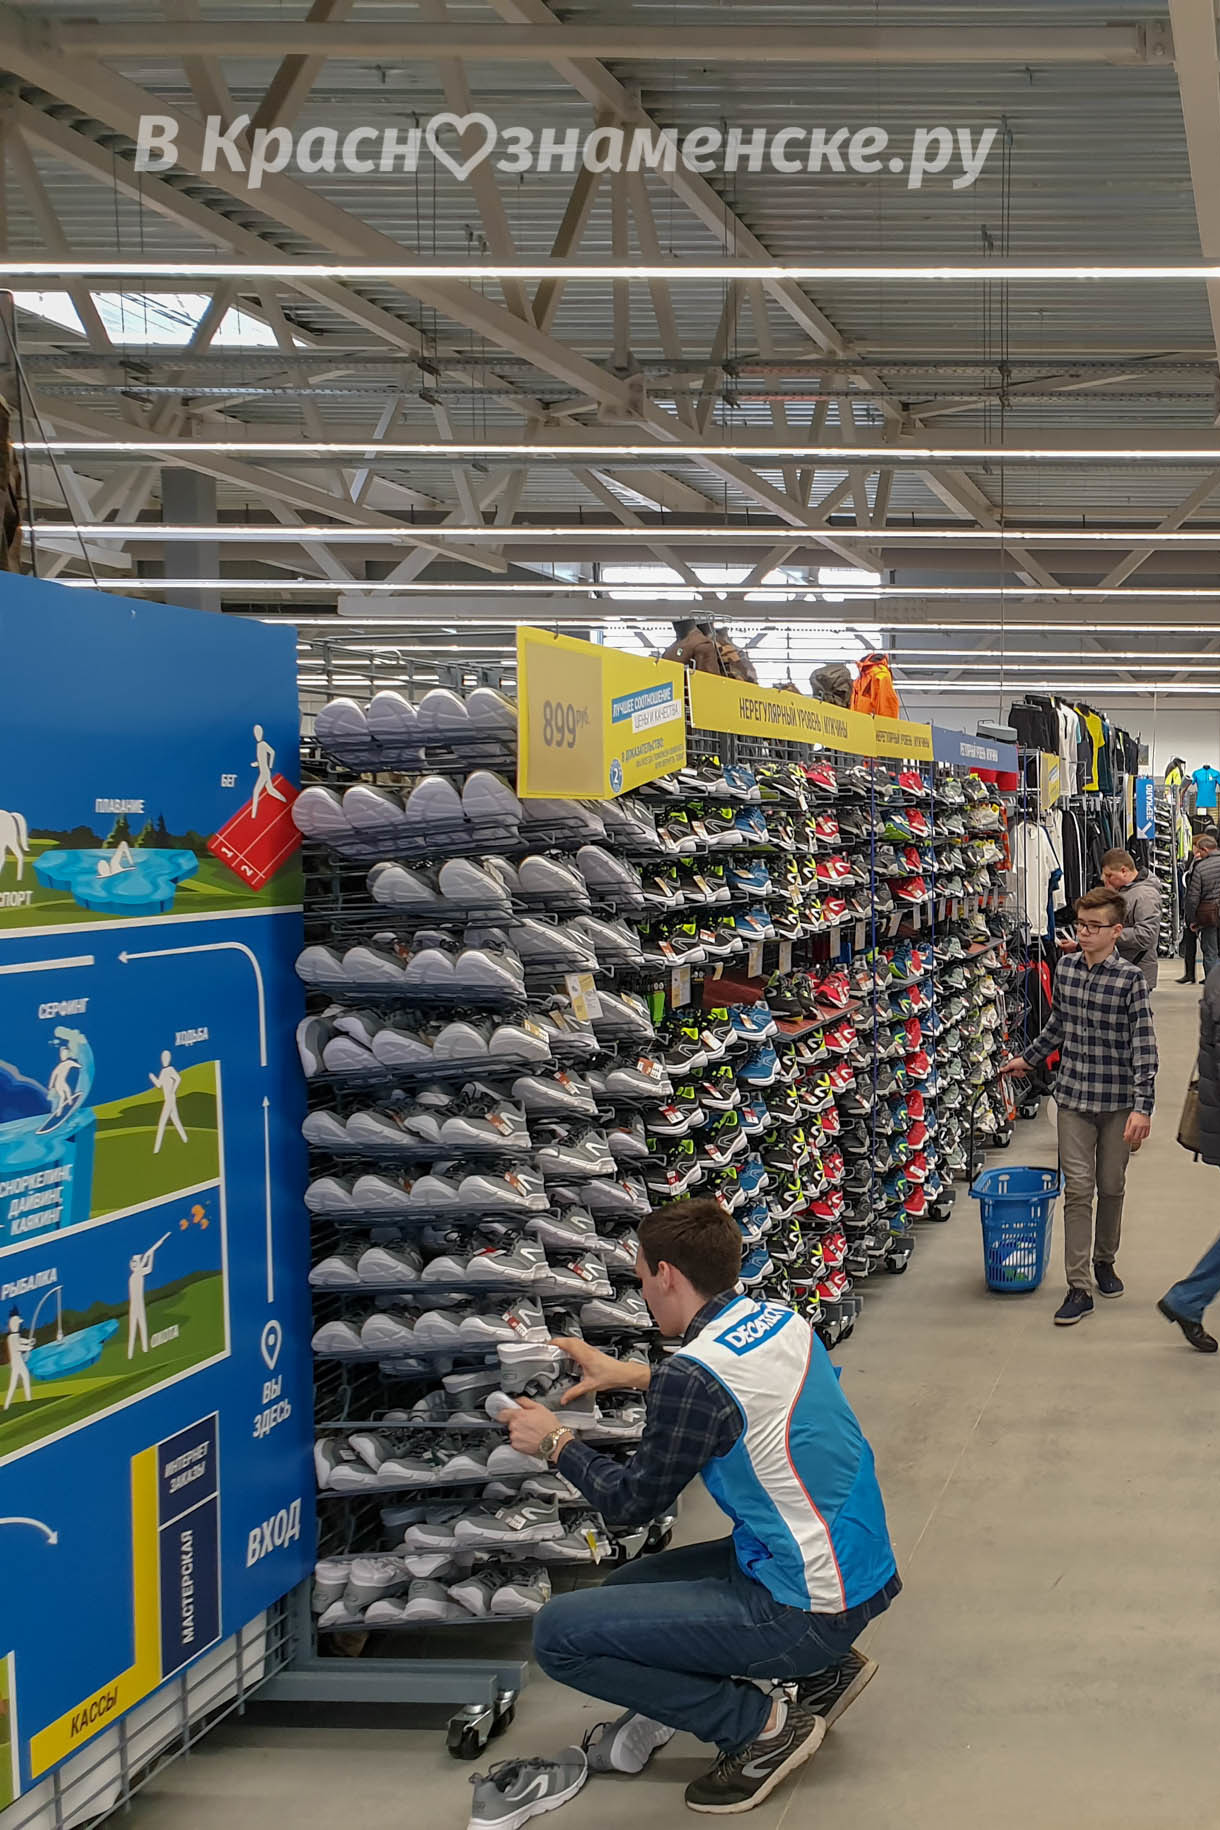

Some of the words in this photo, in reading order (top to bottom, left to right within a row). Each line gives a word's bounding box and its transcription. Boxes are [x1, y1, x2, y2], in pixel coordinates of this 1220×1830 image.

[543, 700, 576, 749] 899
[739, 698, 797, 727] НЕРЕГУЛЯРНЫЙ
[797, 710, 822, 732] УРОВЕНЬ
[824, 717, 848, 739] МУЖЧИНЫ
[1145, 784, 1154, 821] ЗЕРКАЛО
[221, 847, 234, 858] 1
[240, 865, 254, 877] 2
[0, 1268, 58, 1300] РЫБАЛКА
[262, 1374, 283, 1405] ВЫ
[252, 1398, 292, 1439] ЗДЕСЬ
[246, 1498, 301, 1569] ВХОД
[180, 1530, 196, 1645] МАСТЕРСКАЯ
[70, 1686, 119, 1739] КАССЫ
